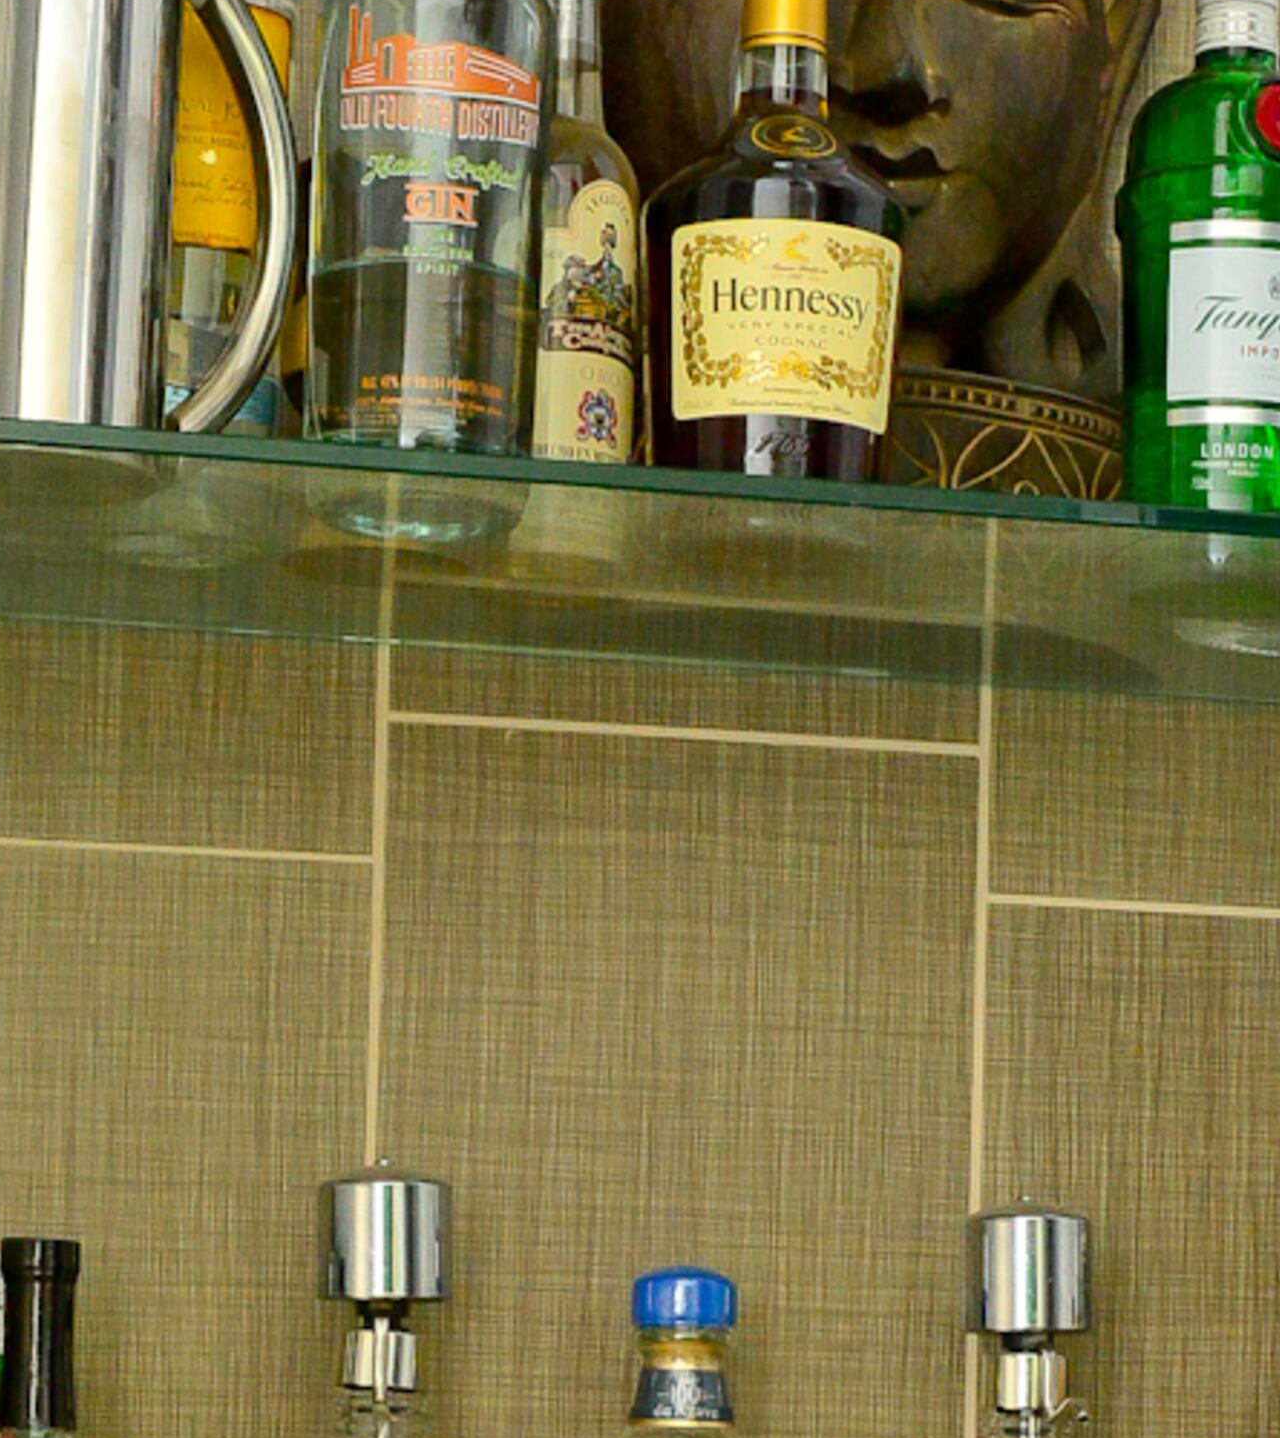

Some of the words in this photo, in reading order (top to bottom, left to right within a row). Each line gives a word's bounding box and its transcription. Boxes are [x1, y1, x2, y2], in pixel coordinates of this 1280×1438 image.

[403, 183, 479, 228] GIN
[712, 278, 870, 330] Hennessy
[1200, 442, 1274, 461] LONDON
